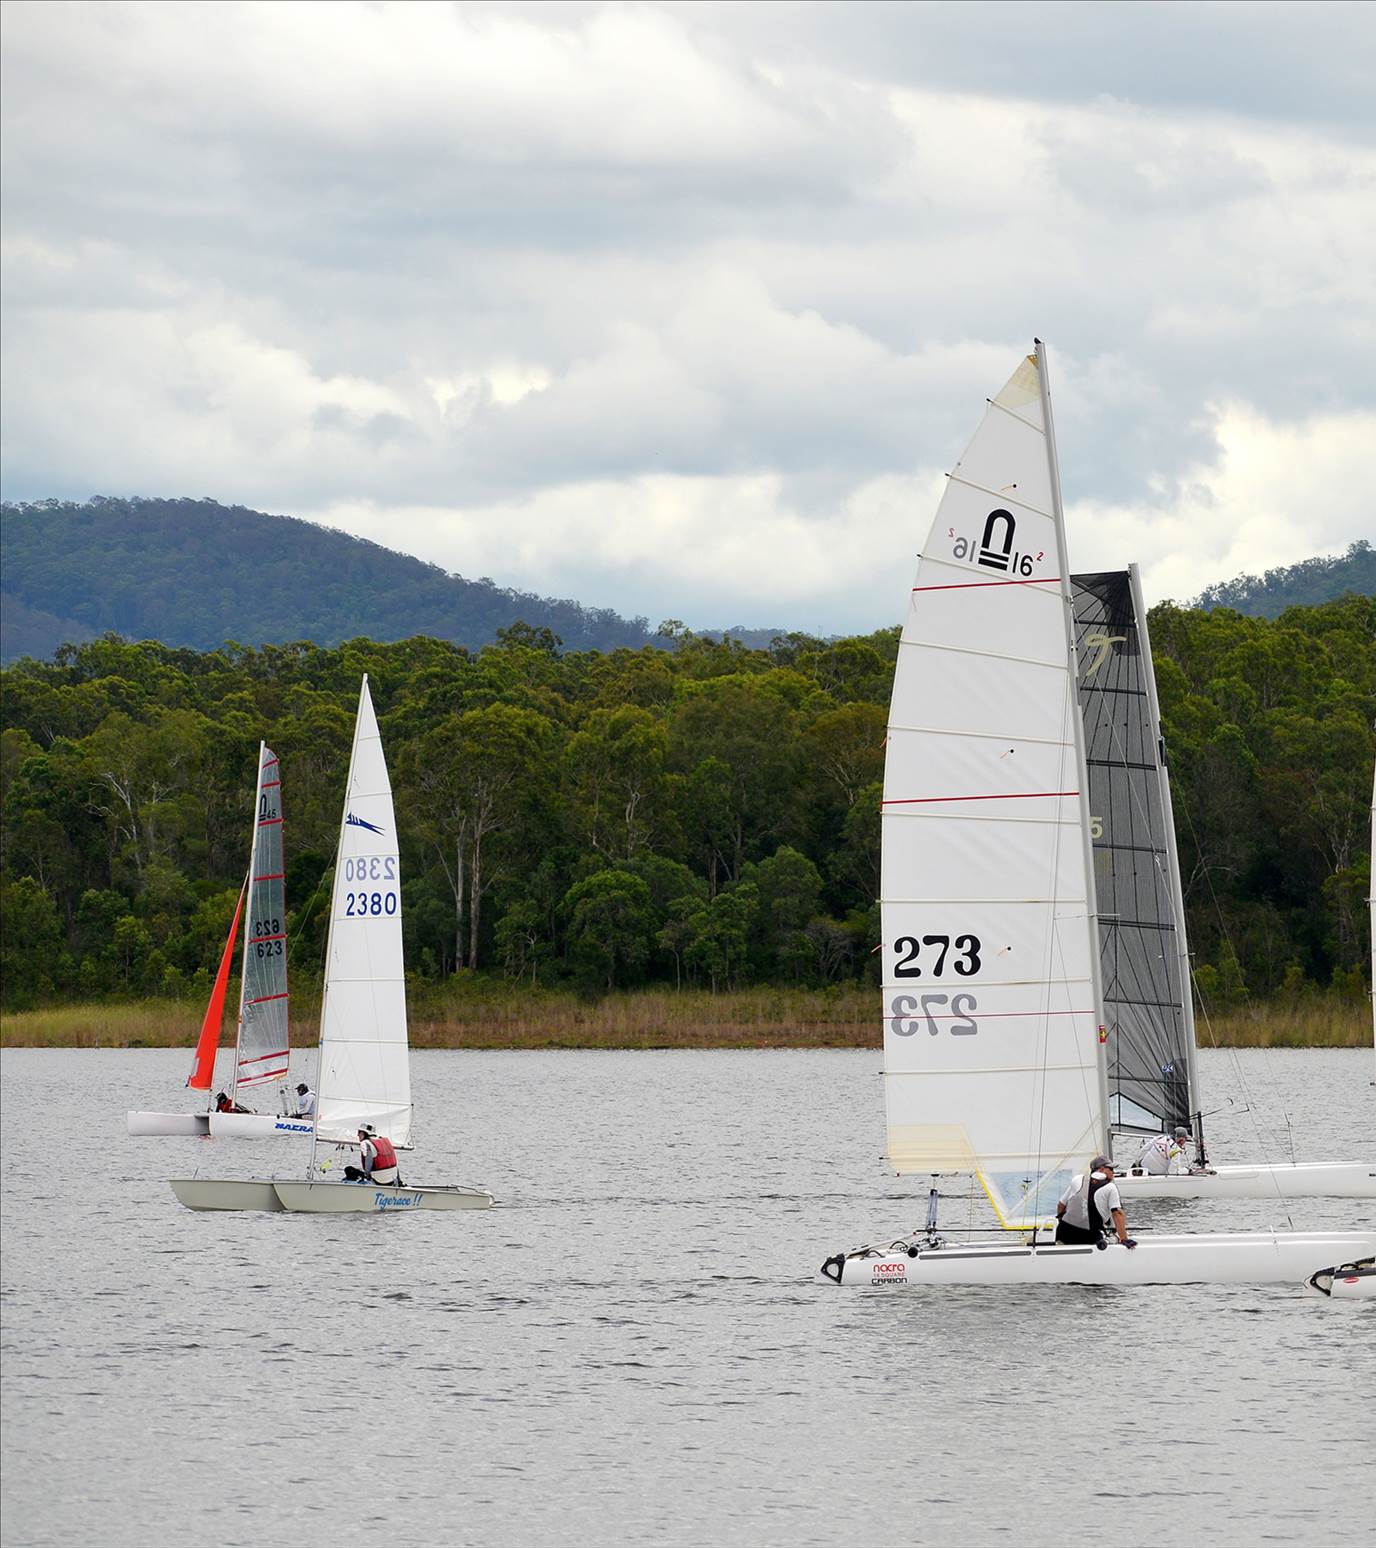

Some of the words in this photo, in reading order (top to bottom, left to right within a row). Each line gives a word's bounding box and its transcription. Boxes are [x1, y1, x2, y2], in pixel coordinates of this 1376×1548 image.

[345, 892, 397, 917] 2380
[257, 940, 283, 958] 623
[893, 934, 982, 979] 273
